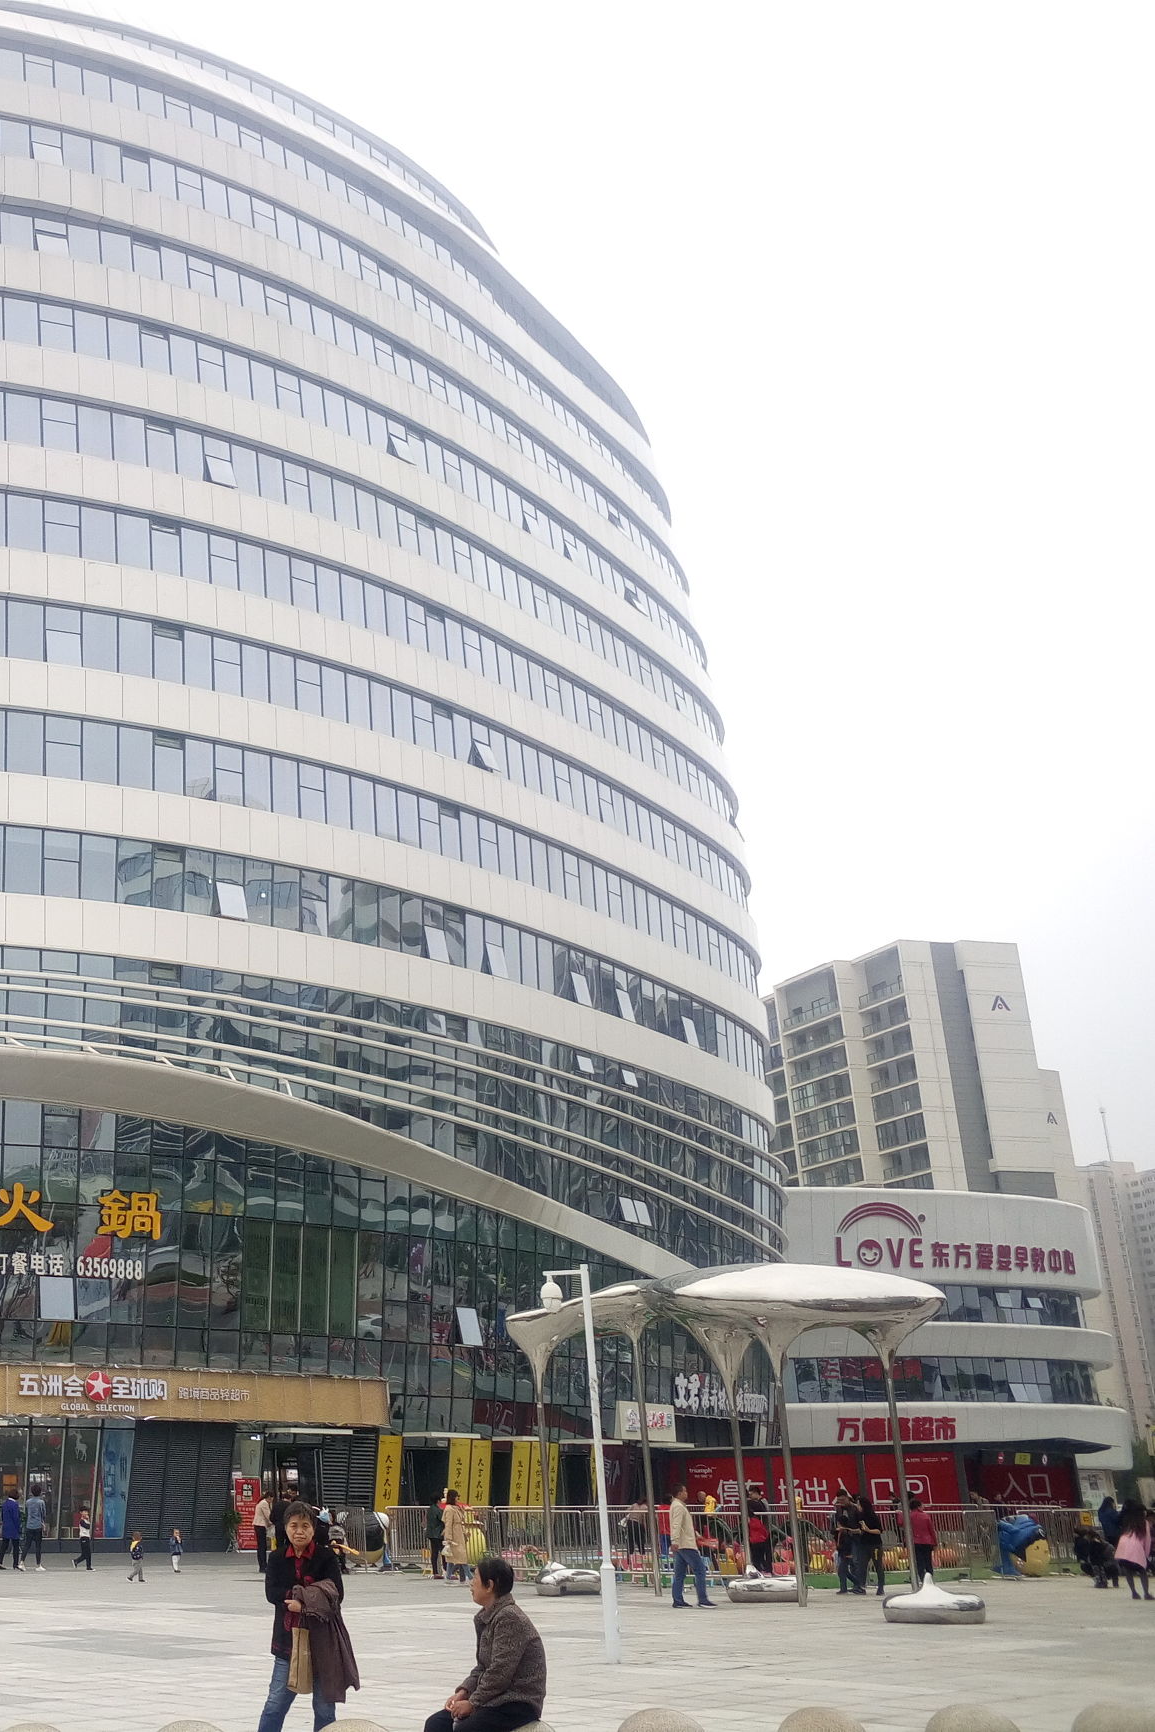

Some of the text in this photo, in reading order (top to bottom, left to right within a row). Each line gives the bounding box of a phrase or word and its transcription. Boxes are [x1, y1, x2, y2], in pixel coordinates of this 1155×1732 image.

[76, 1256, 143, 1281] 63569888
[931, 1241, 1076, 1275] 东方爱婴早教中心
[19, 1373, 250, 1402] 五洲会 全球购 跨境商品轻超市
[61, 1403, 135, 1413] GLOBAL SELECTION
[1003, 1472, 1052, 1498] 入口
